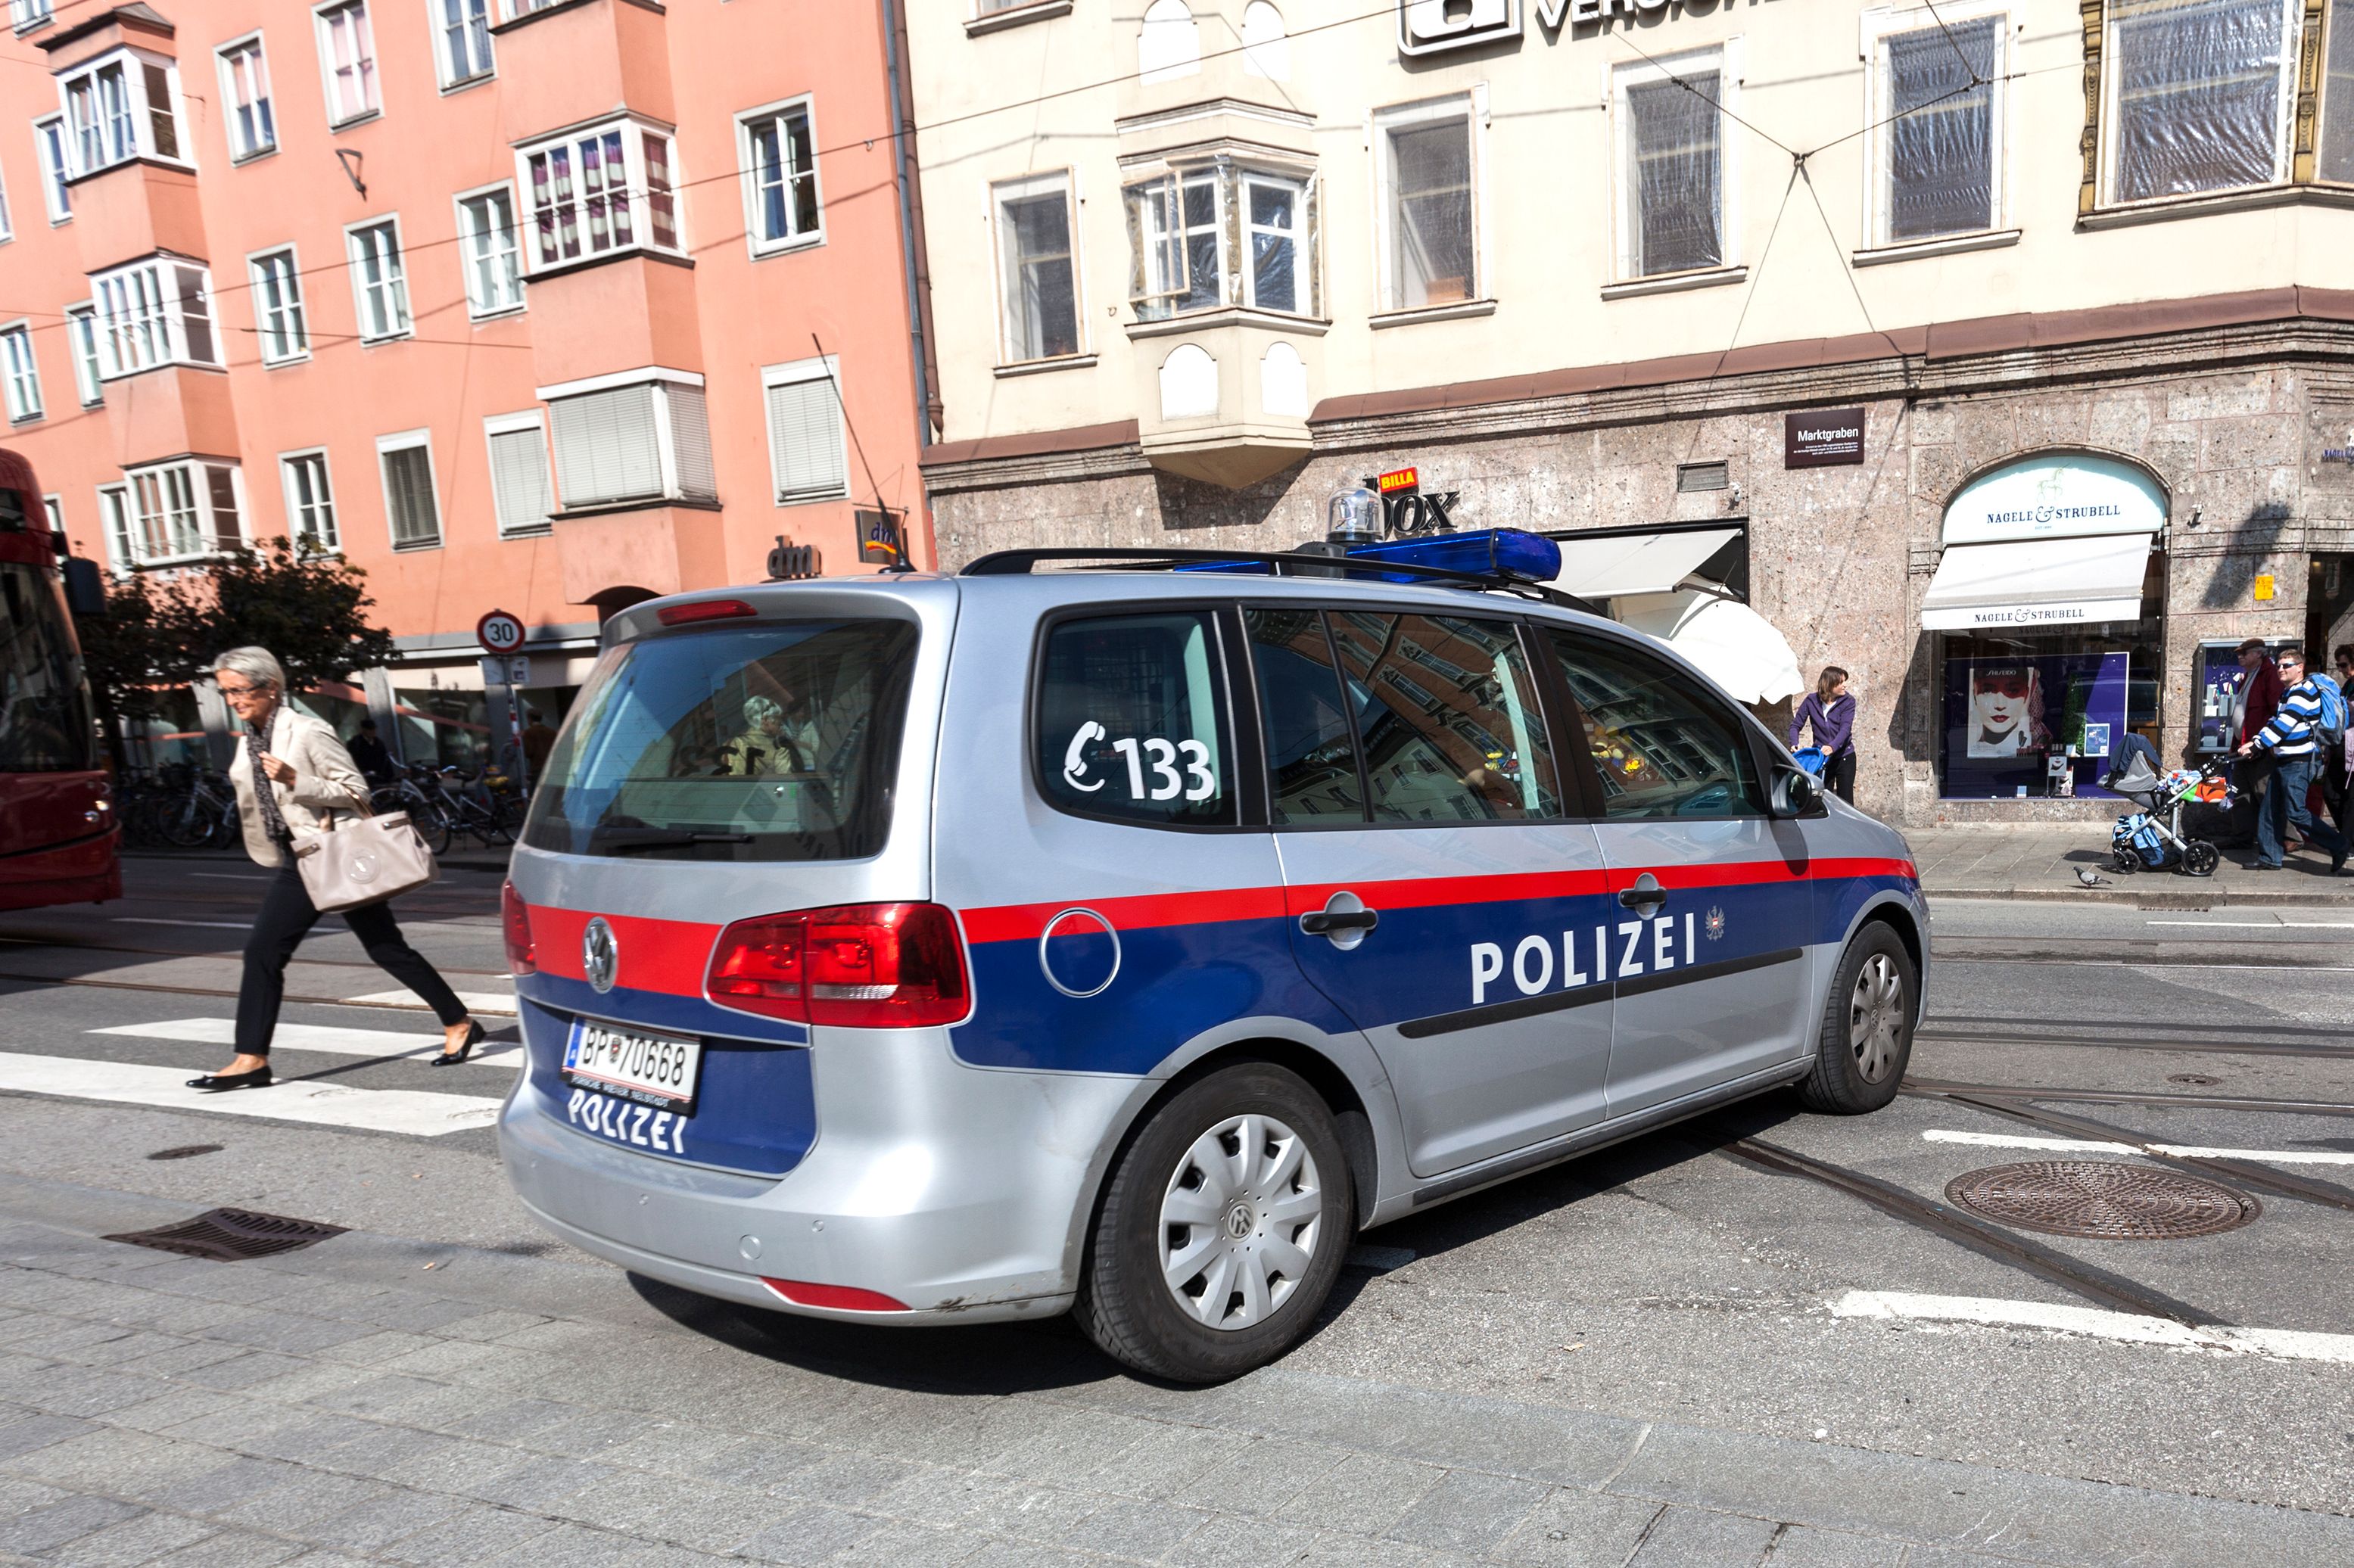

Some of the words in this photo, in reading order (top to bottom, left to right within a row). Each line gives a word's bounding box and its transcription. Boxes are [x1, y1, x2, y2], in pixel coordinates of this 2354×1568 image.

[1798, 427, 1858, 441] Marktgraben
[1381, 471, 1415, 489] BILLA
[2035, 506, 2054, 523] &
[2056, 505, 2121, 519] STRUBELL
[2015, 608, 2030, 622] &
[2031, 608, 2085, 620] STRUBELL
[488, 623, 514, 642] 30
[1112, 738, 1216, 801] 133
[1471, 913, 1695, 1005] POLIZEI
[583, 1027, 607, 1067] BP
[618, 1034, 686, 1087] 70668
[568, 1088, 688, 1154] POLIZEI
